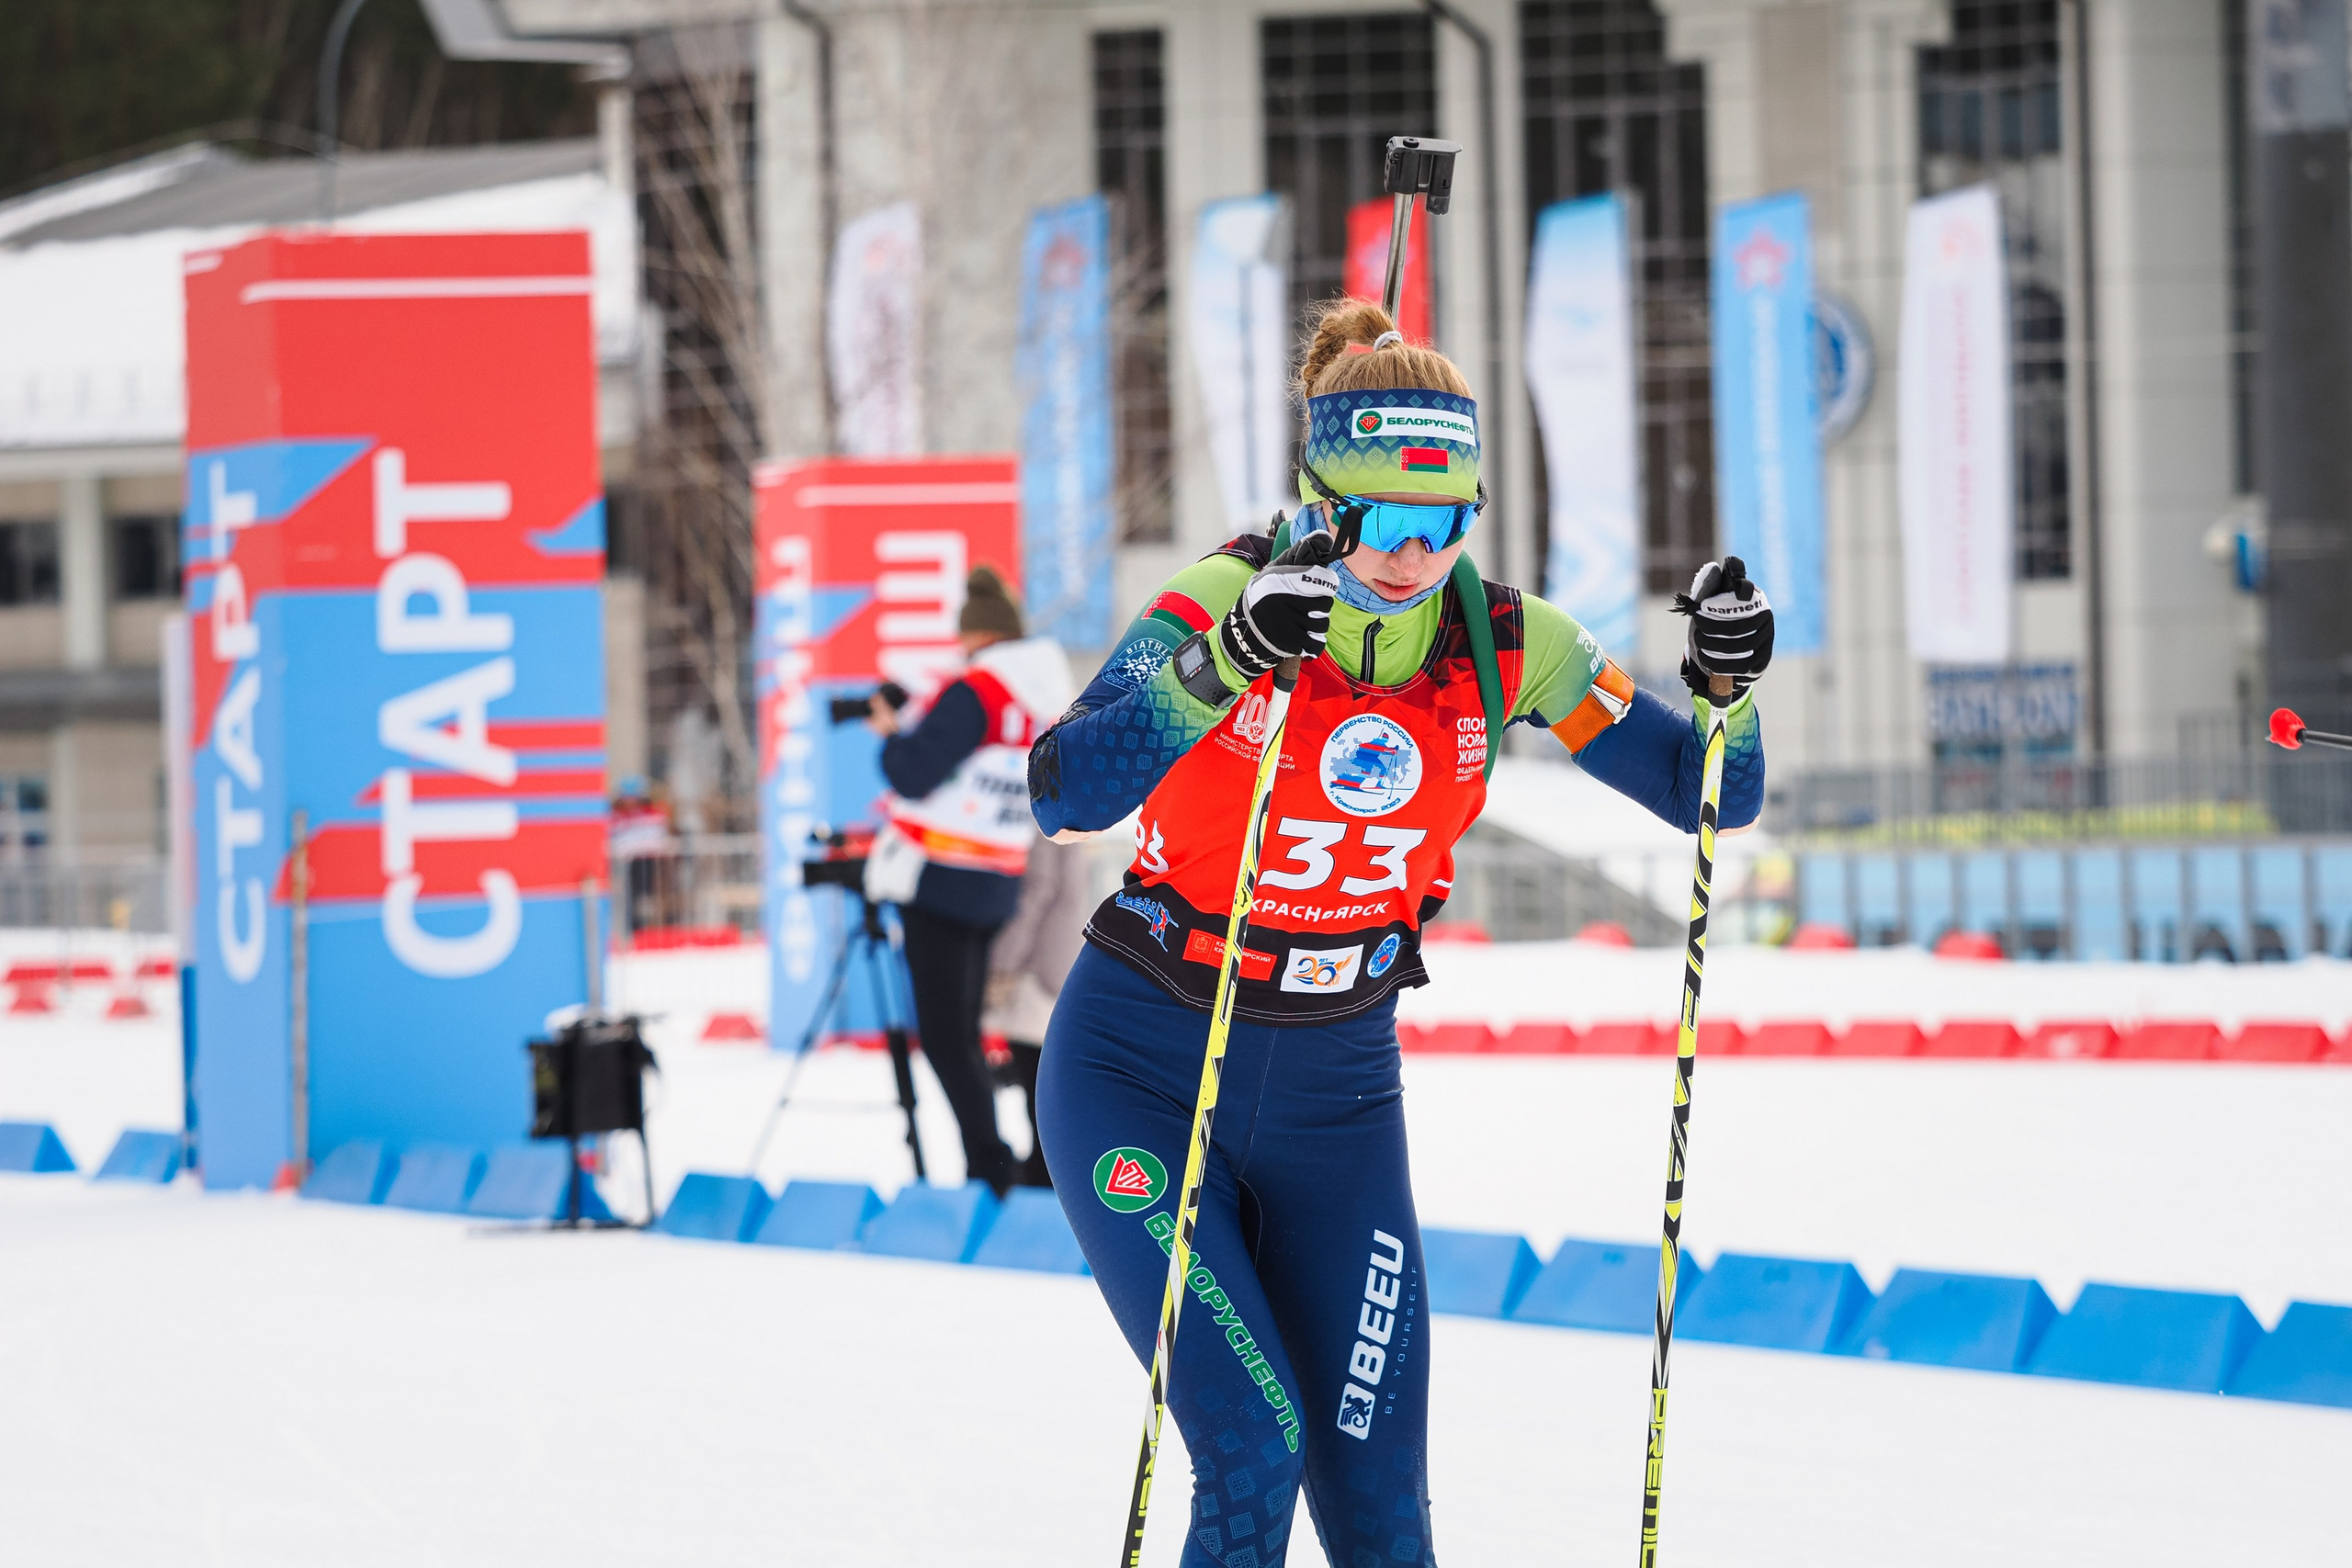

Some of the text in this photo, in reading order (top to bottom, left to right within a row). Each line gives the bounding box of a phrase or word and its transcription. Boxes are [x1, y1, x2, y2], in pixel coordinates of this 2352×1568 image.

[1386, 417, 1474, 435] БЕЛОРУСНЕФТЬ
[209, 459, 266, 984] СТАРТ
[372, 446, 523, 978] СТАРТ
[1456, 716, 1487, 732] СПОР
[1219, 732, 1262, 755] МИНИСТЕРСТВ
[1330, 716, 1414, 749] ПЕРВЕНСТВО РОССИИ
[1457, 733, 1487, 749] НОРМ
[1335, 795, 1377, 814] Красноярск
[1381, 797, 1401, 811] 2023
[1257, 816, 1428, 897] 33
[1348, 1228, 1405, 1386] BEEU
[1385, 1266, 1418, 1415] BE YOURSELF
